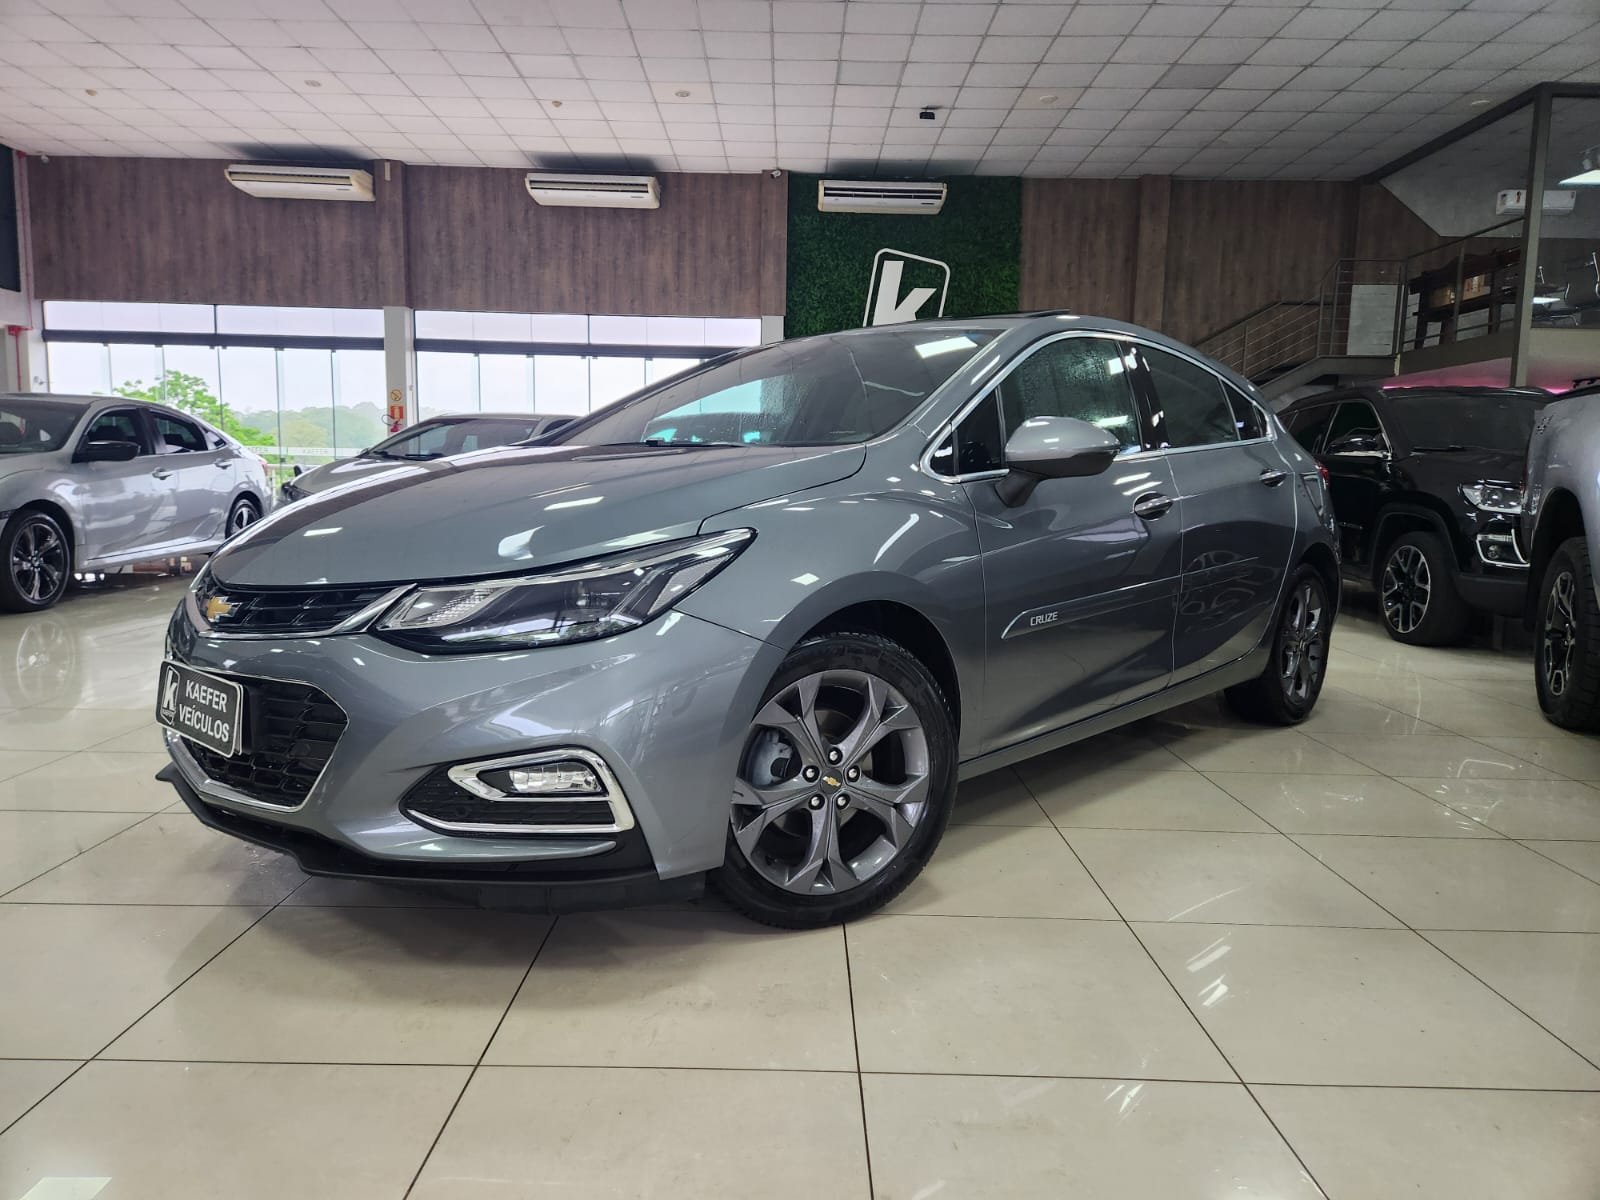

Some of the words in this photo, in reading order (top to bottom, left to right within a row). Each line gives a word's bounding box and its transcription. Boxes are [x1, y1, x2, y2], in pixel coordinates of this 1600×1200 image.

[1030, 611, 1059, 627] CRUZE
[185, 679, 228, 713] KAEFER
[179, 703, 230, 742] VEÍCULOS
